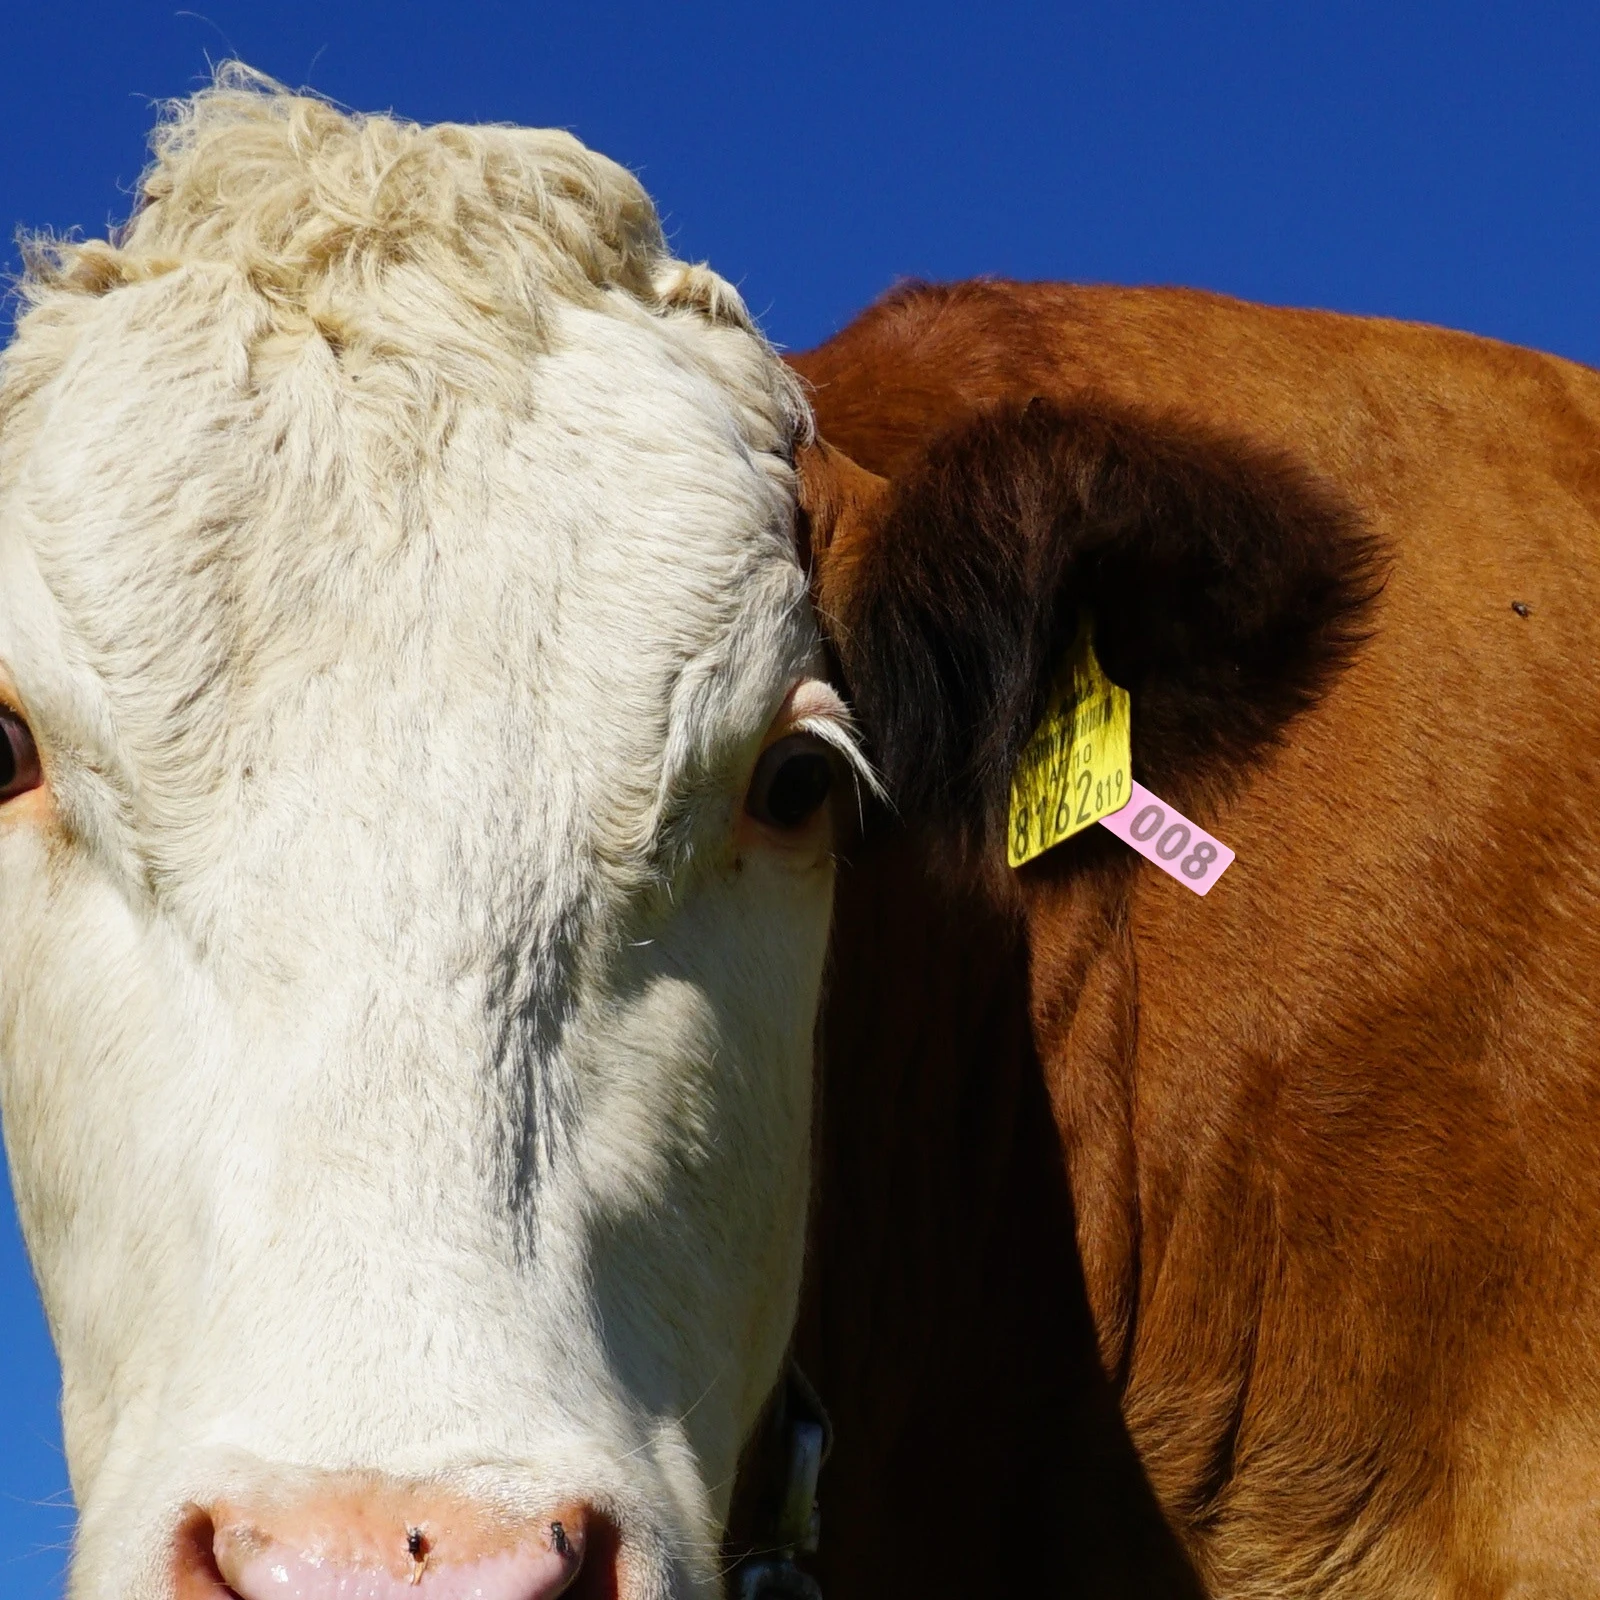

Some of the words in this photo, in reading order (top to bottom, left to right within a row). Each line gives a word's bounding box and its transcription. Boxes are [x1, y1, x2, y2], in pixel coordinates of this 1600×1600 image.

[1074, 743, 1092, 768] 10
[1013, 770, 1092, 860] 8162
[1095, 769, 1123, 812] 819
[1130, 804, 1218, 880] 008
